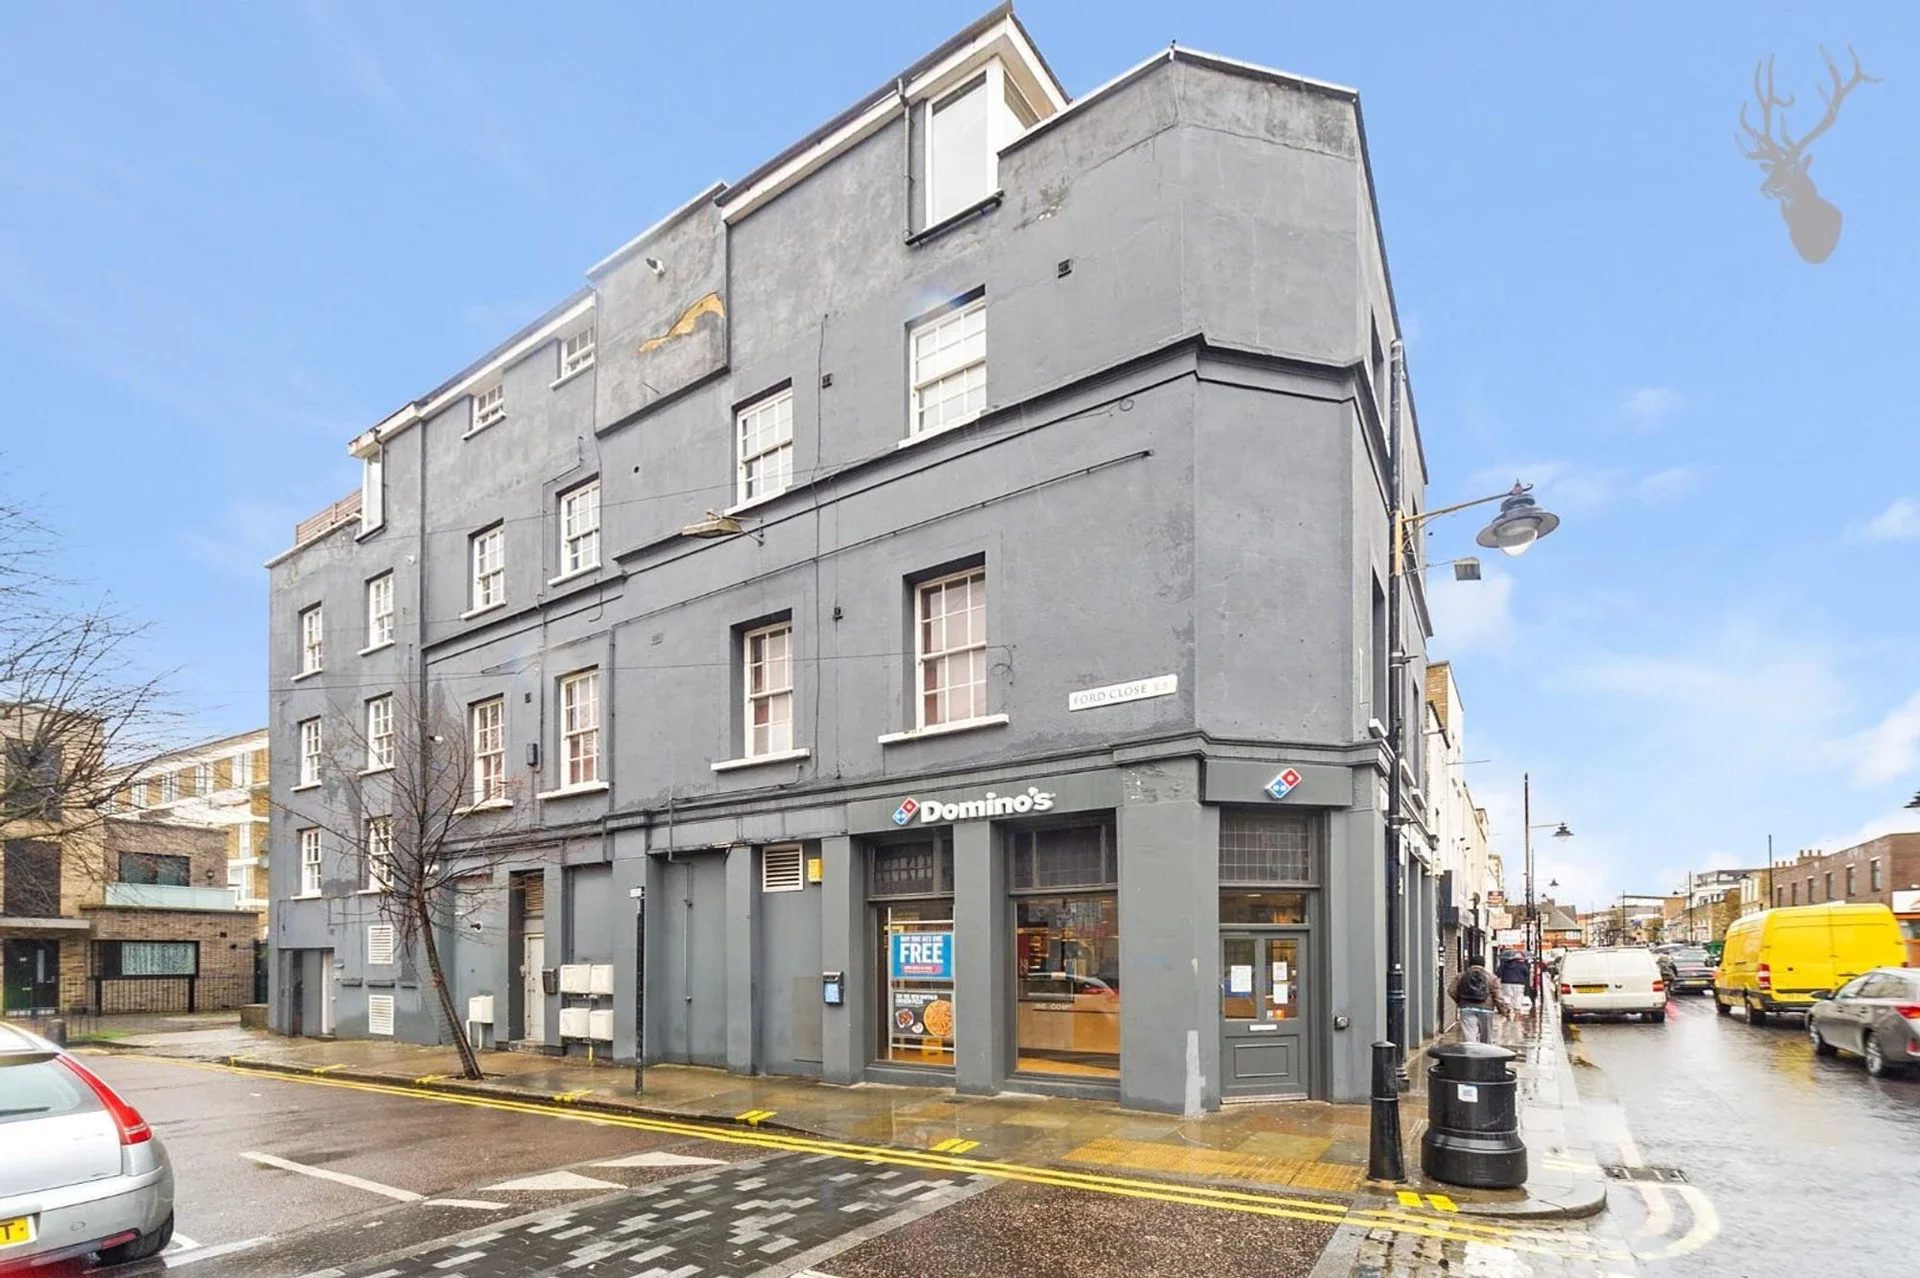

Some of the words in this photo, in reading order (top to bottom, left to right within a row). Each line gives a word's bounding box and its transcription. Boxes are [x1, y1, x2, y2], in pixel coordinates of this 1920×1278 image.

[1074, 692, 1106, 705] FORD
[1109, 684, 1148, 699] CLOSE
[920, 786, 1055, 824] Domino's
[900, 943, 944, 964] FREE
